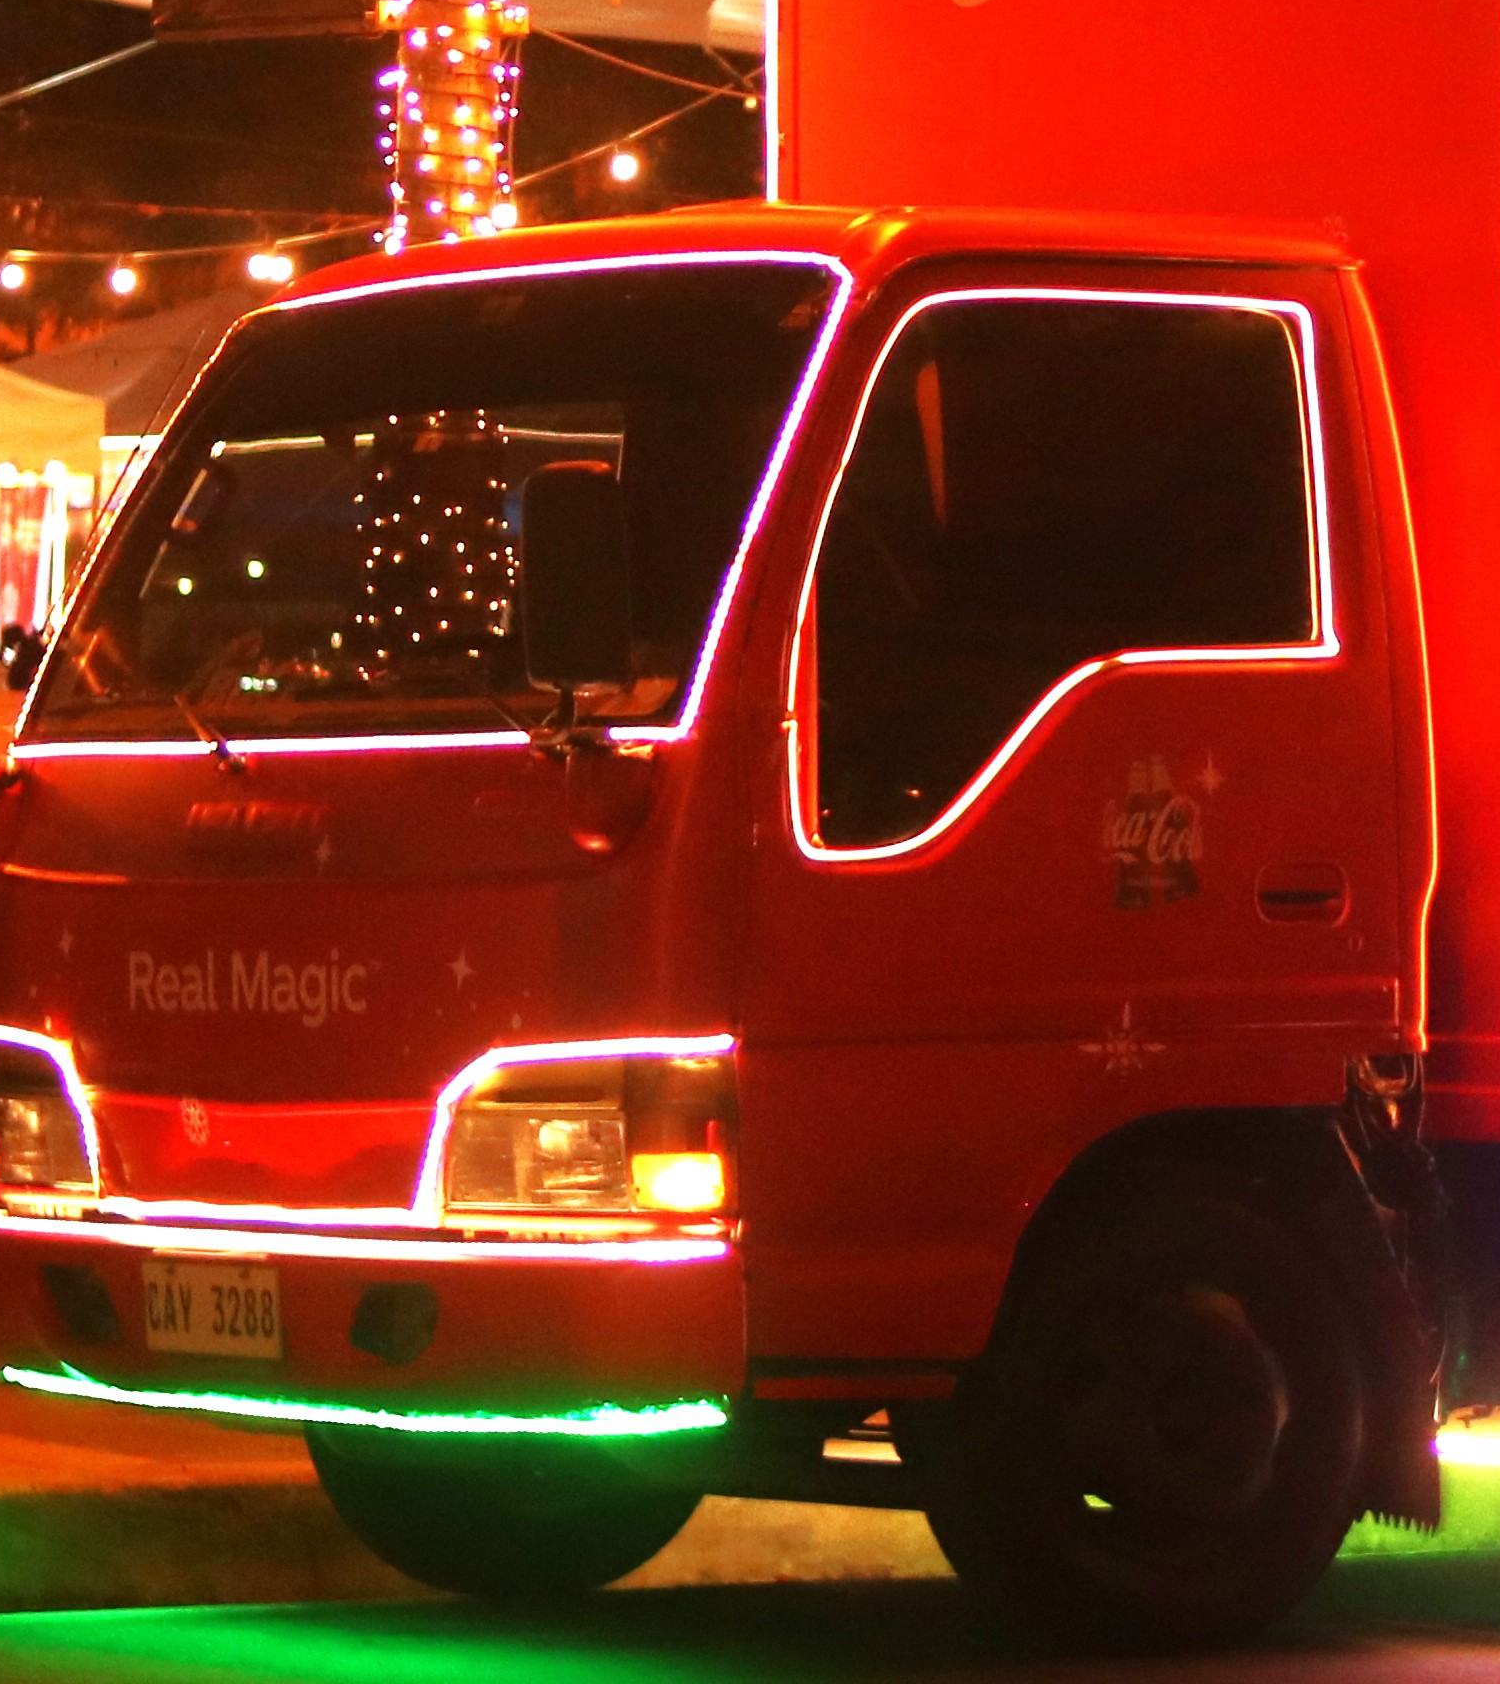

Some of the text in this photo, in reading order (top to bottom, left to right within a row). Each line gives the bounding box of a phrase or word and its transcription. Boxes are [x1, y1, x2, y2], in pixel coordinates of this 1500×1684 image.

[129, 947, 367, 1027] Real Magic
[148, 1281, 275, 1338] CAY 3288
